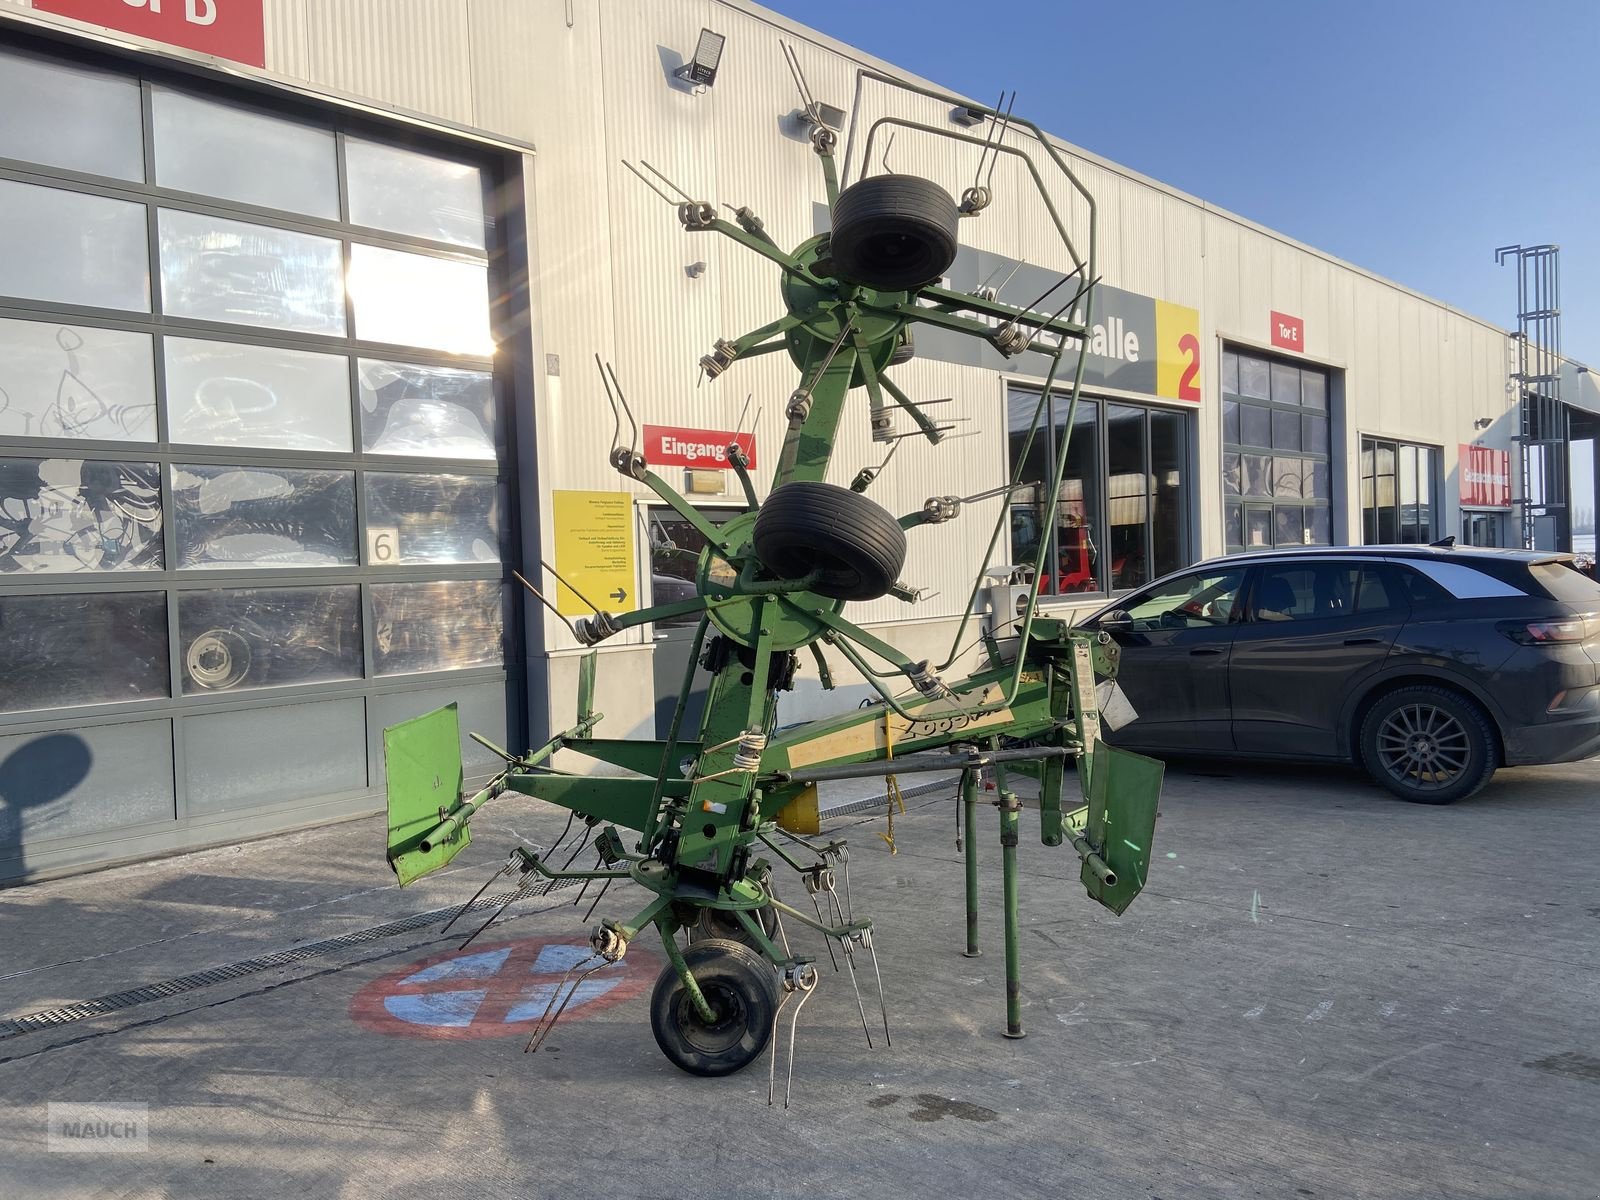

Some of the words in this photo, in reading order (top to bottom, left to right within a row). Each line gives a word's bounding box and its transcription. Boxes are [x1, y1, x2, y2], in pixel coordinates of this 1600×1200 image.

[1279, 323, 1291, 339] Tor
[1292, 327, 1297, 341] E
[1177, 333, 1201, 402] 2
[661, 436, 726, 462] Eingang
[375, 533, 392, 561] 6
